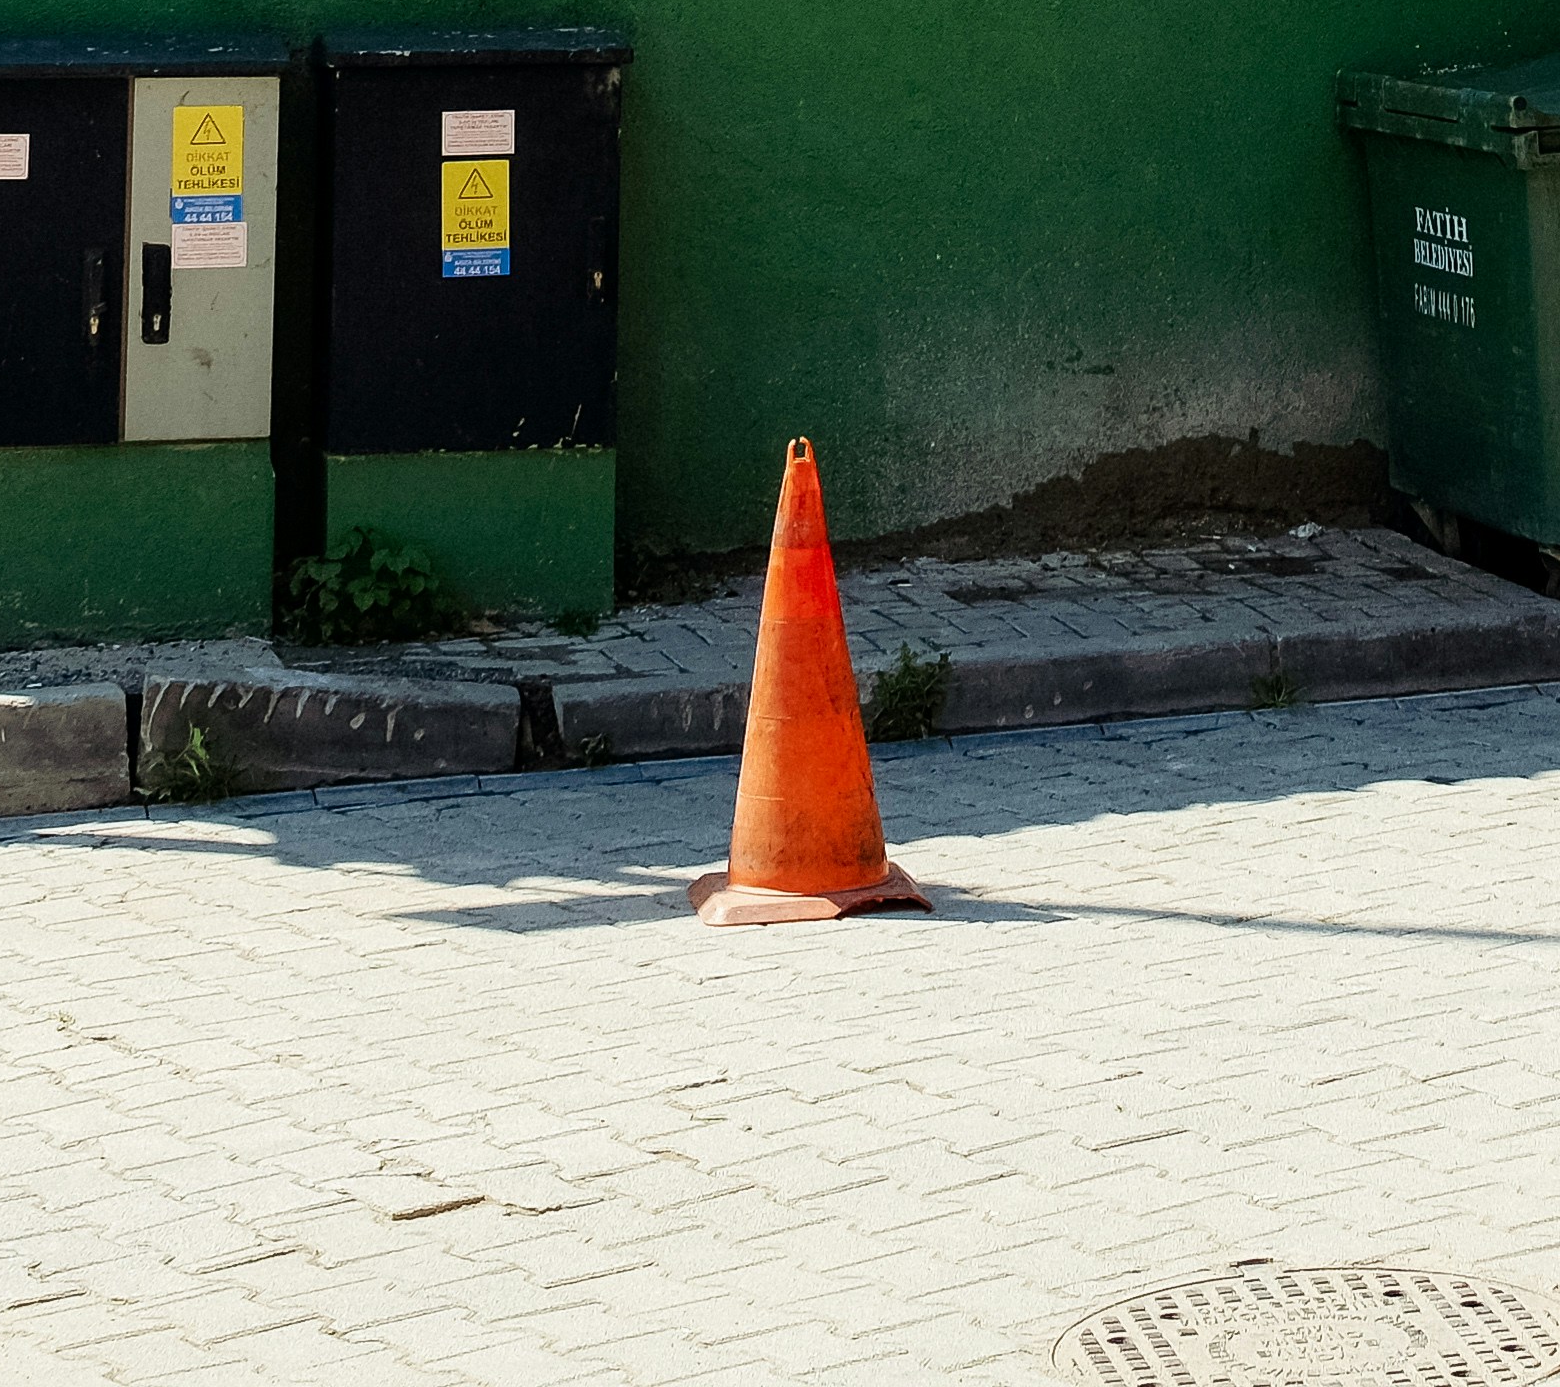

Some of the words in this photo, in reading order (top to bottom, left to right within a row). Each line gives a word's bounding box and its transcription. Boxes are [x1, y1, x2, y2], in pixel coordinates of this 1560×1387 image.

[186, 150, 231, 163] DİKKAT
[190, 164, 226, 176] ÖLÜM
[177, 176, 239, 190] TEHLİKESİ
[454, 204, 498, 217] DİKKAT
[458, 218, 493, 230] ÖLÜM
[1415, 206, 1469, 243] FATİH
[445, 229, 507, 244] TEHLİKESİ
[1414, 238, 1473, 277] BELEDİYESİ
[1461, 295, 1476, 329] 176
